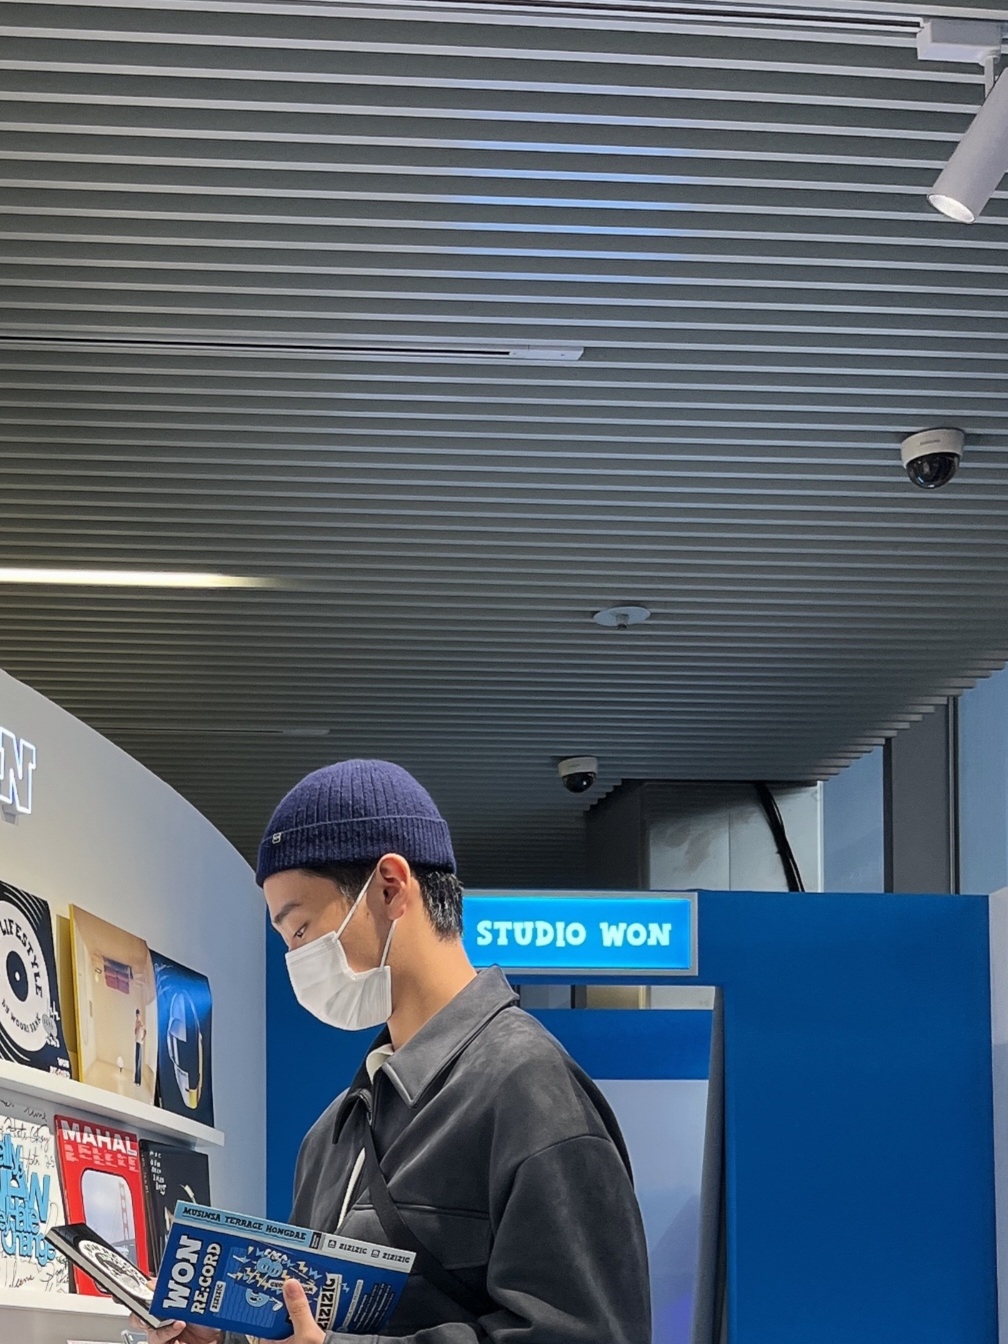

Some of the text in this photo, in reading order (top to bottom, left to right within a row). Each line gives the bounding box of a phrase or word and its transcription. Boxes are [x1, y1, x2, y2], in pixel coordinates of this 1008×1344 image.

[477, 920, 672, 948] STUDIO WON
[60, 1120, 138, 1157] MAHAL
[6, 1196, 40, 1235] Hate
[183, 1206, 221, 1222] MUSINSA
[224, 1216, 264, 1232] TERRACE
[266, 1223, 307, 1240] HONGDAE
[339, 1242, 410, 1264] ZIZIZIC ZIZIZIC
[163, 1233, 205, 1309] WON
[191, 1242, 224, 1314] RE:CORD
[211, 1283, 224, 1310] ZIZIZIC
